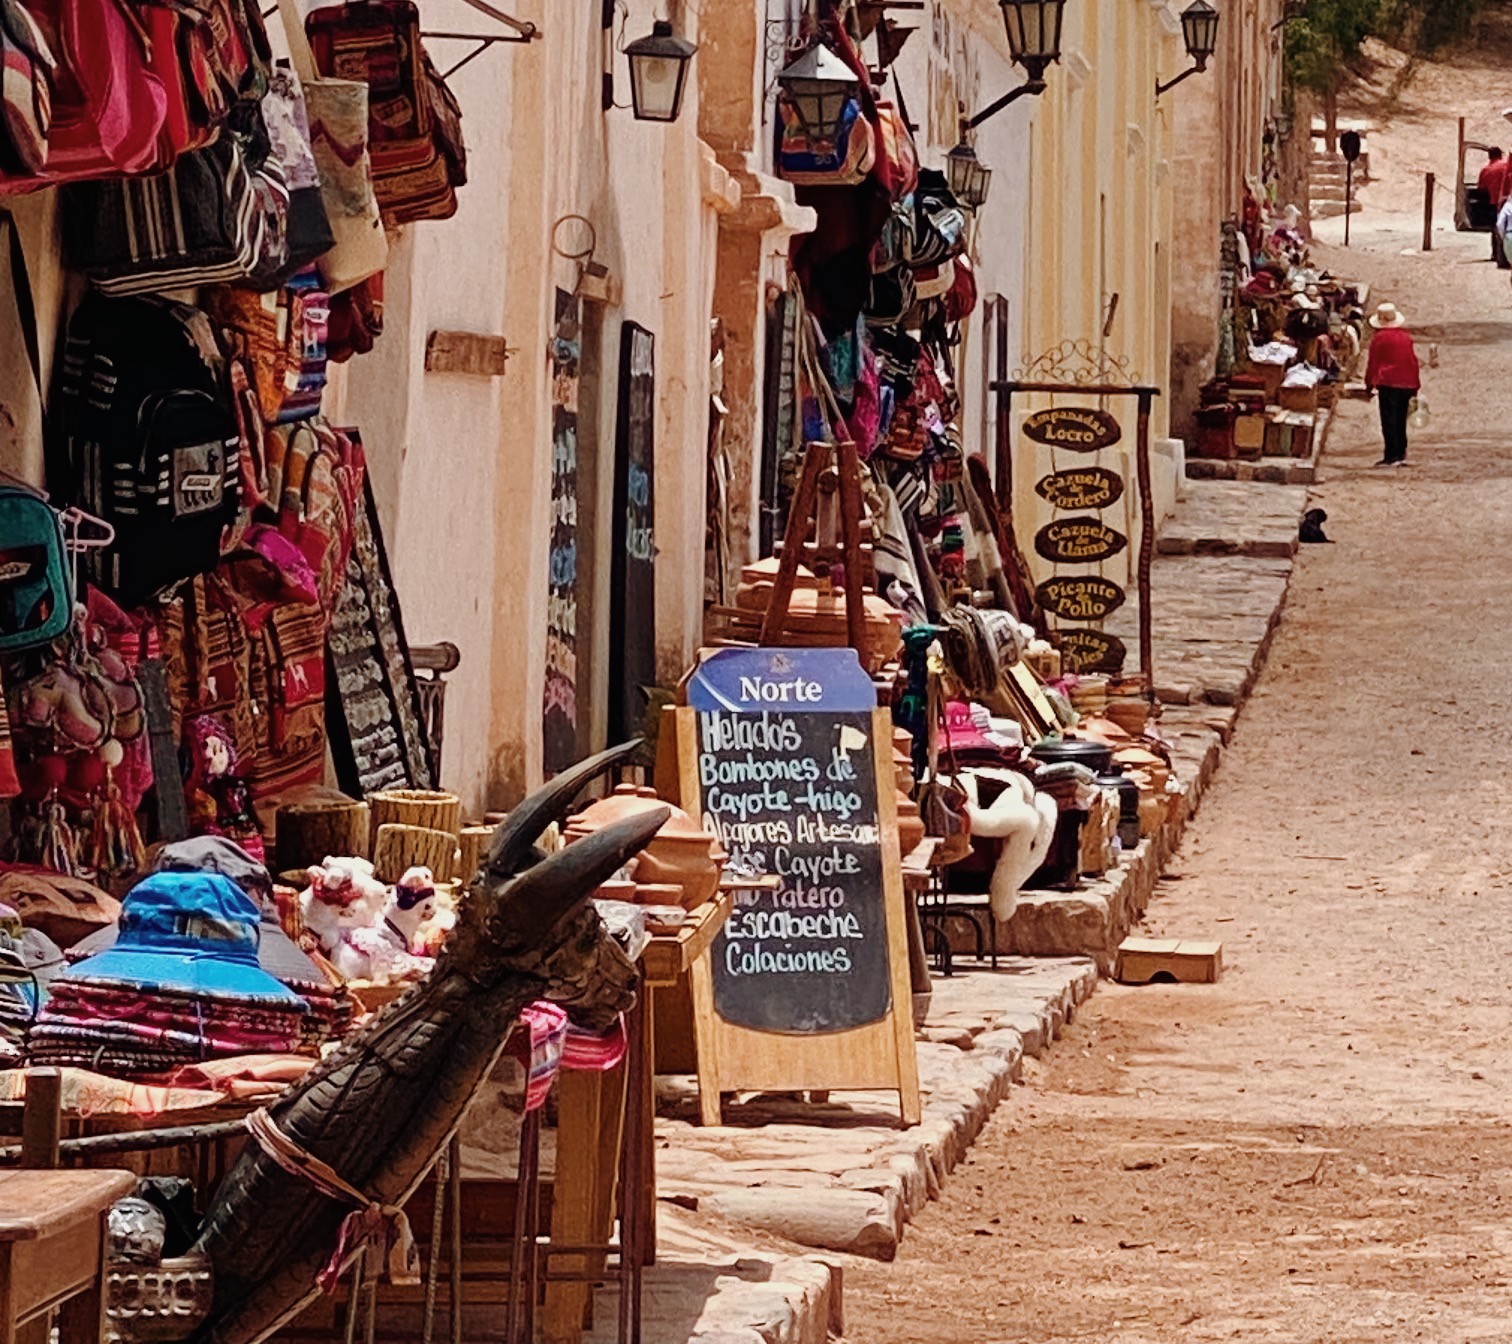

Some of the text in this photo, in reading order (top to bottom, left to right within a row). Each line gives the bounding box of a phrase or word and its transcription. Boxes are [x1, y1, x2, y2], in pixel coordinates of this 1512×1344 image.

[1026, 411, 1106, 436] Empanadas
[1044, 424, 1094, 442] Locro
[1043, 473, 1109, 491] Cazuela
[1046, 490, 1110, 508] Cordero
[1048, 524, 1115, 544] Cazuela
[1057, 540, 1109, 556] Llama
[1047, 582, 1117, 600] Picante
[1058, 598, 1106, 616] Pollo
[739, 676, 823, 702] Norte
[700, 746, 858, 786] Bombones de
[708, 782, 792, 822] Cayote
[775, 845, 862, 884] Cayote
[771, 878, 845, 909] Patero
[724, 909, 864, 939] Escabeche
[726, 941, 852, 976] Colaciones
